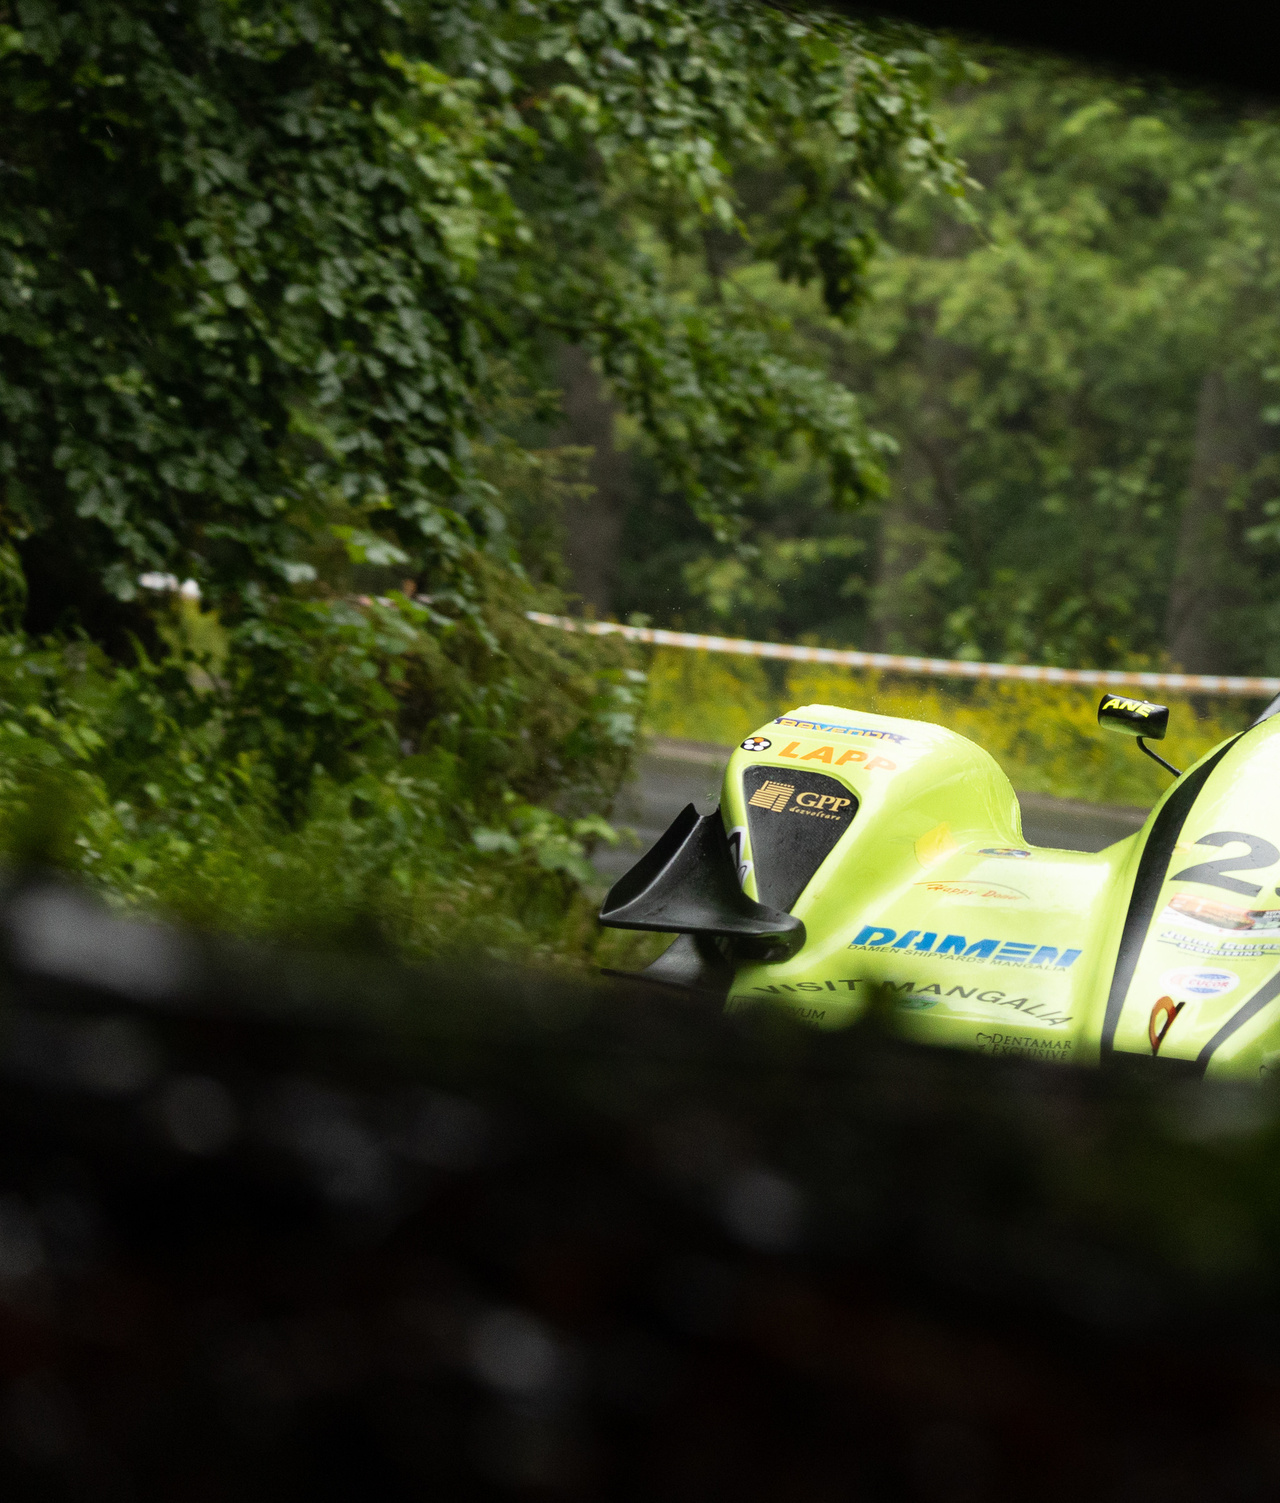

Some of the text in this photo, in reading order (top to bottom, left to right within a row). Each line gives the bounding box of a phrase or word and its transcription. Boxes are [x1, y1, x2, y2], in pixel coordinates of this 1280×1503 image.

[1102, 698, 1156, 718] ANE
[778, 741, 897, 770] LAPP
[796, 791, 851, 812] GPP
[847, 944, 1067, 973] DAMEN SHIPYARDS MANGALIA
[851, 924, 1083, 967] DAMEN
[750, 978, 1074, 1026] VISIT MANGALIA
[990, 1032, 1072, 1049] DENTAMAR
